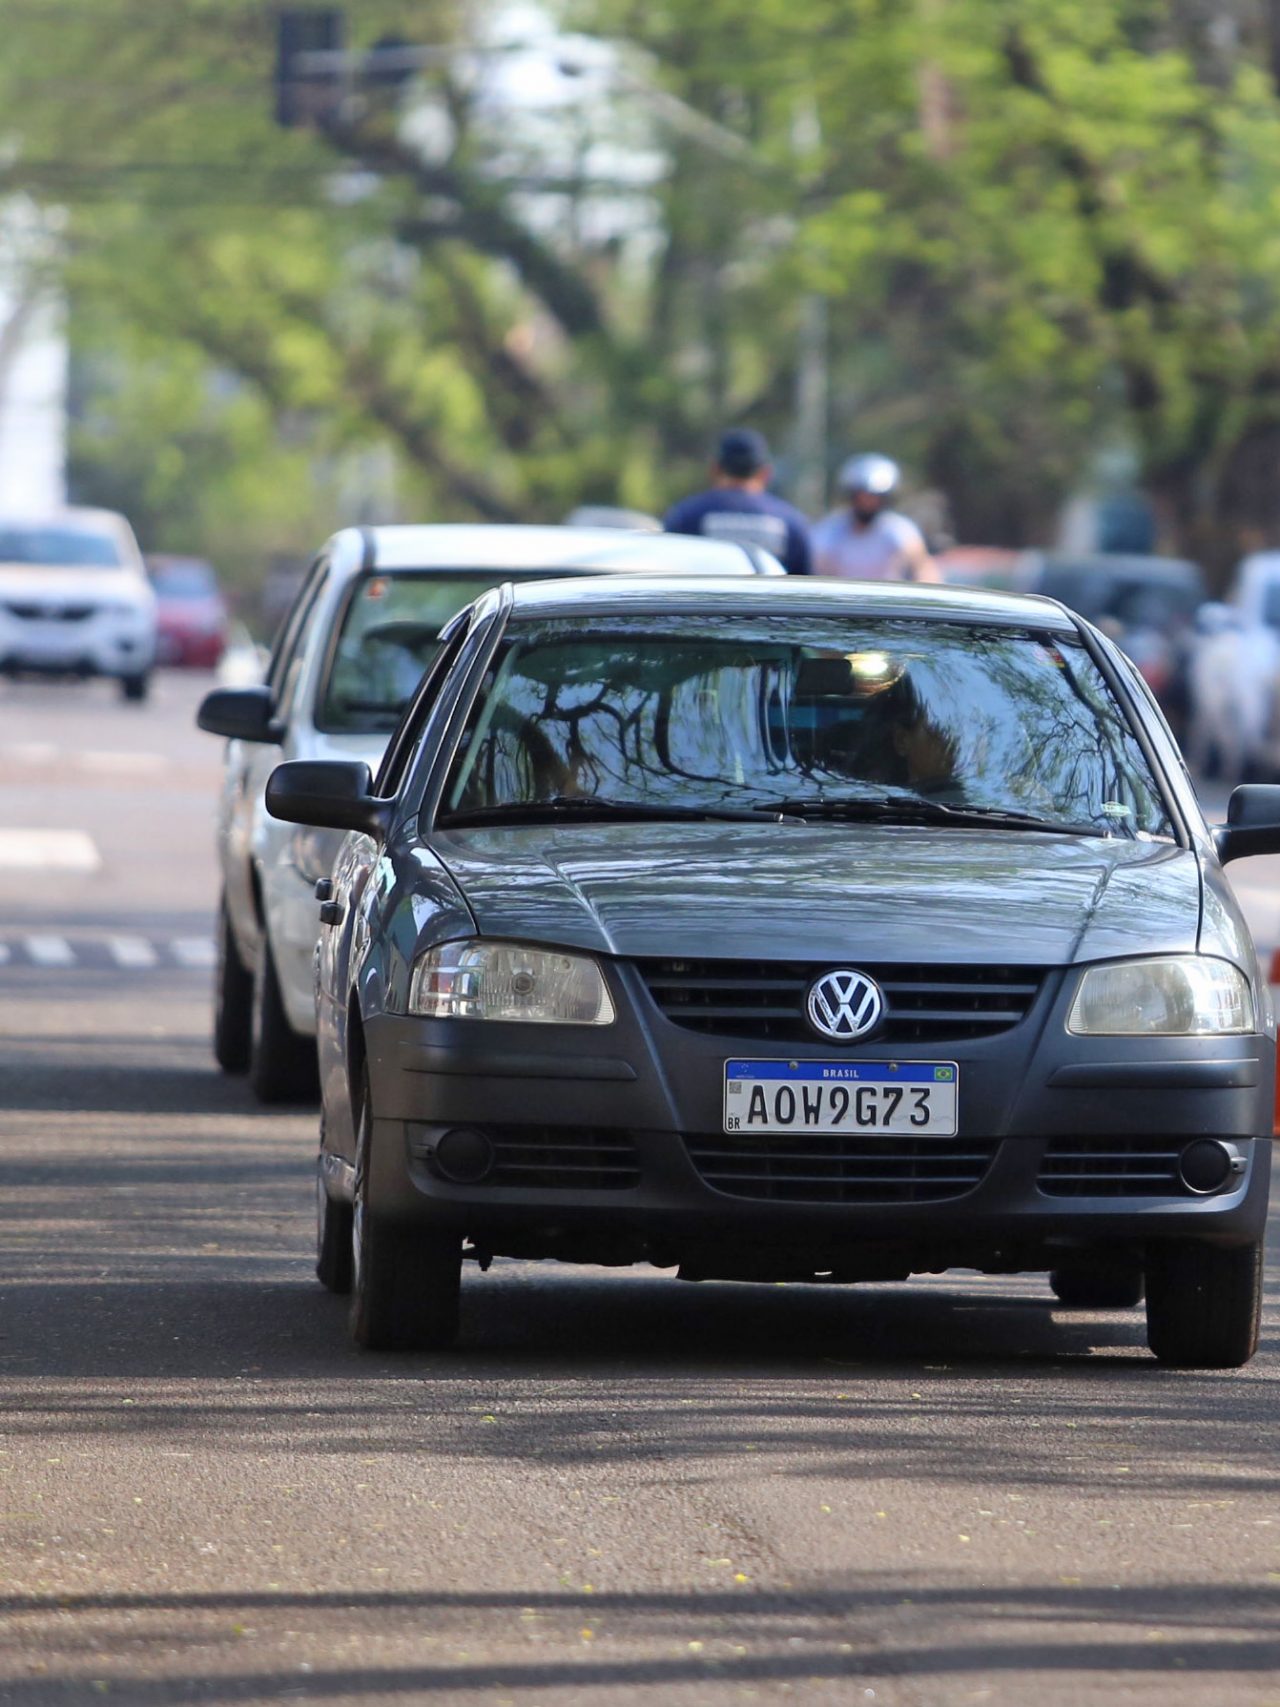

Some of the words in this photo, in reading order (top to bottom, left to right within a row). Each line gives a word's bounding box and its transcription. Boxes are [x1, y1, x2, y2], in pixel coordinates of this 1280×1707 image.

[823, 1069, 859, 1078] BRASIL
[747, 1085, 931, 1126] AOW9G73
[728, 1117, 740, 1130] BR
